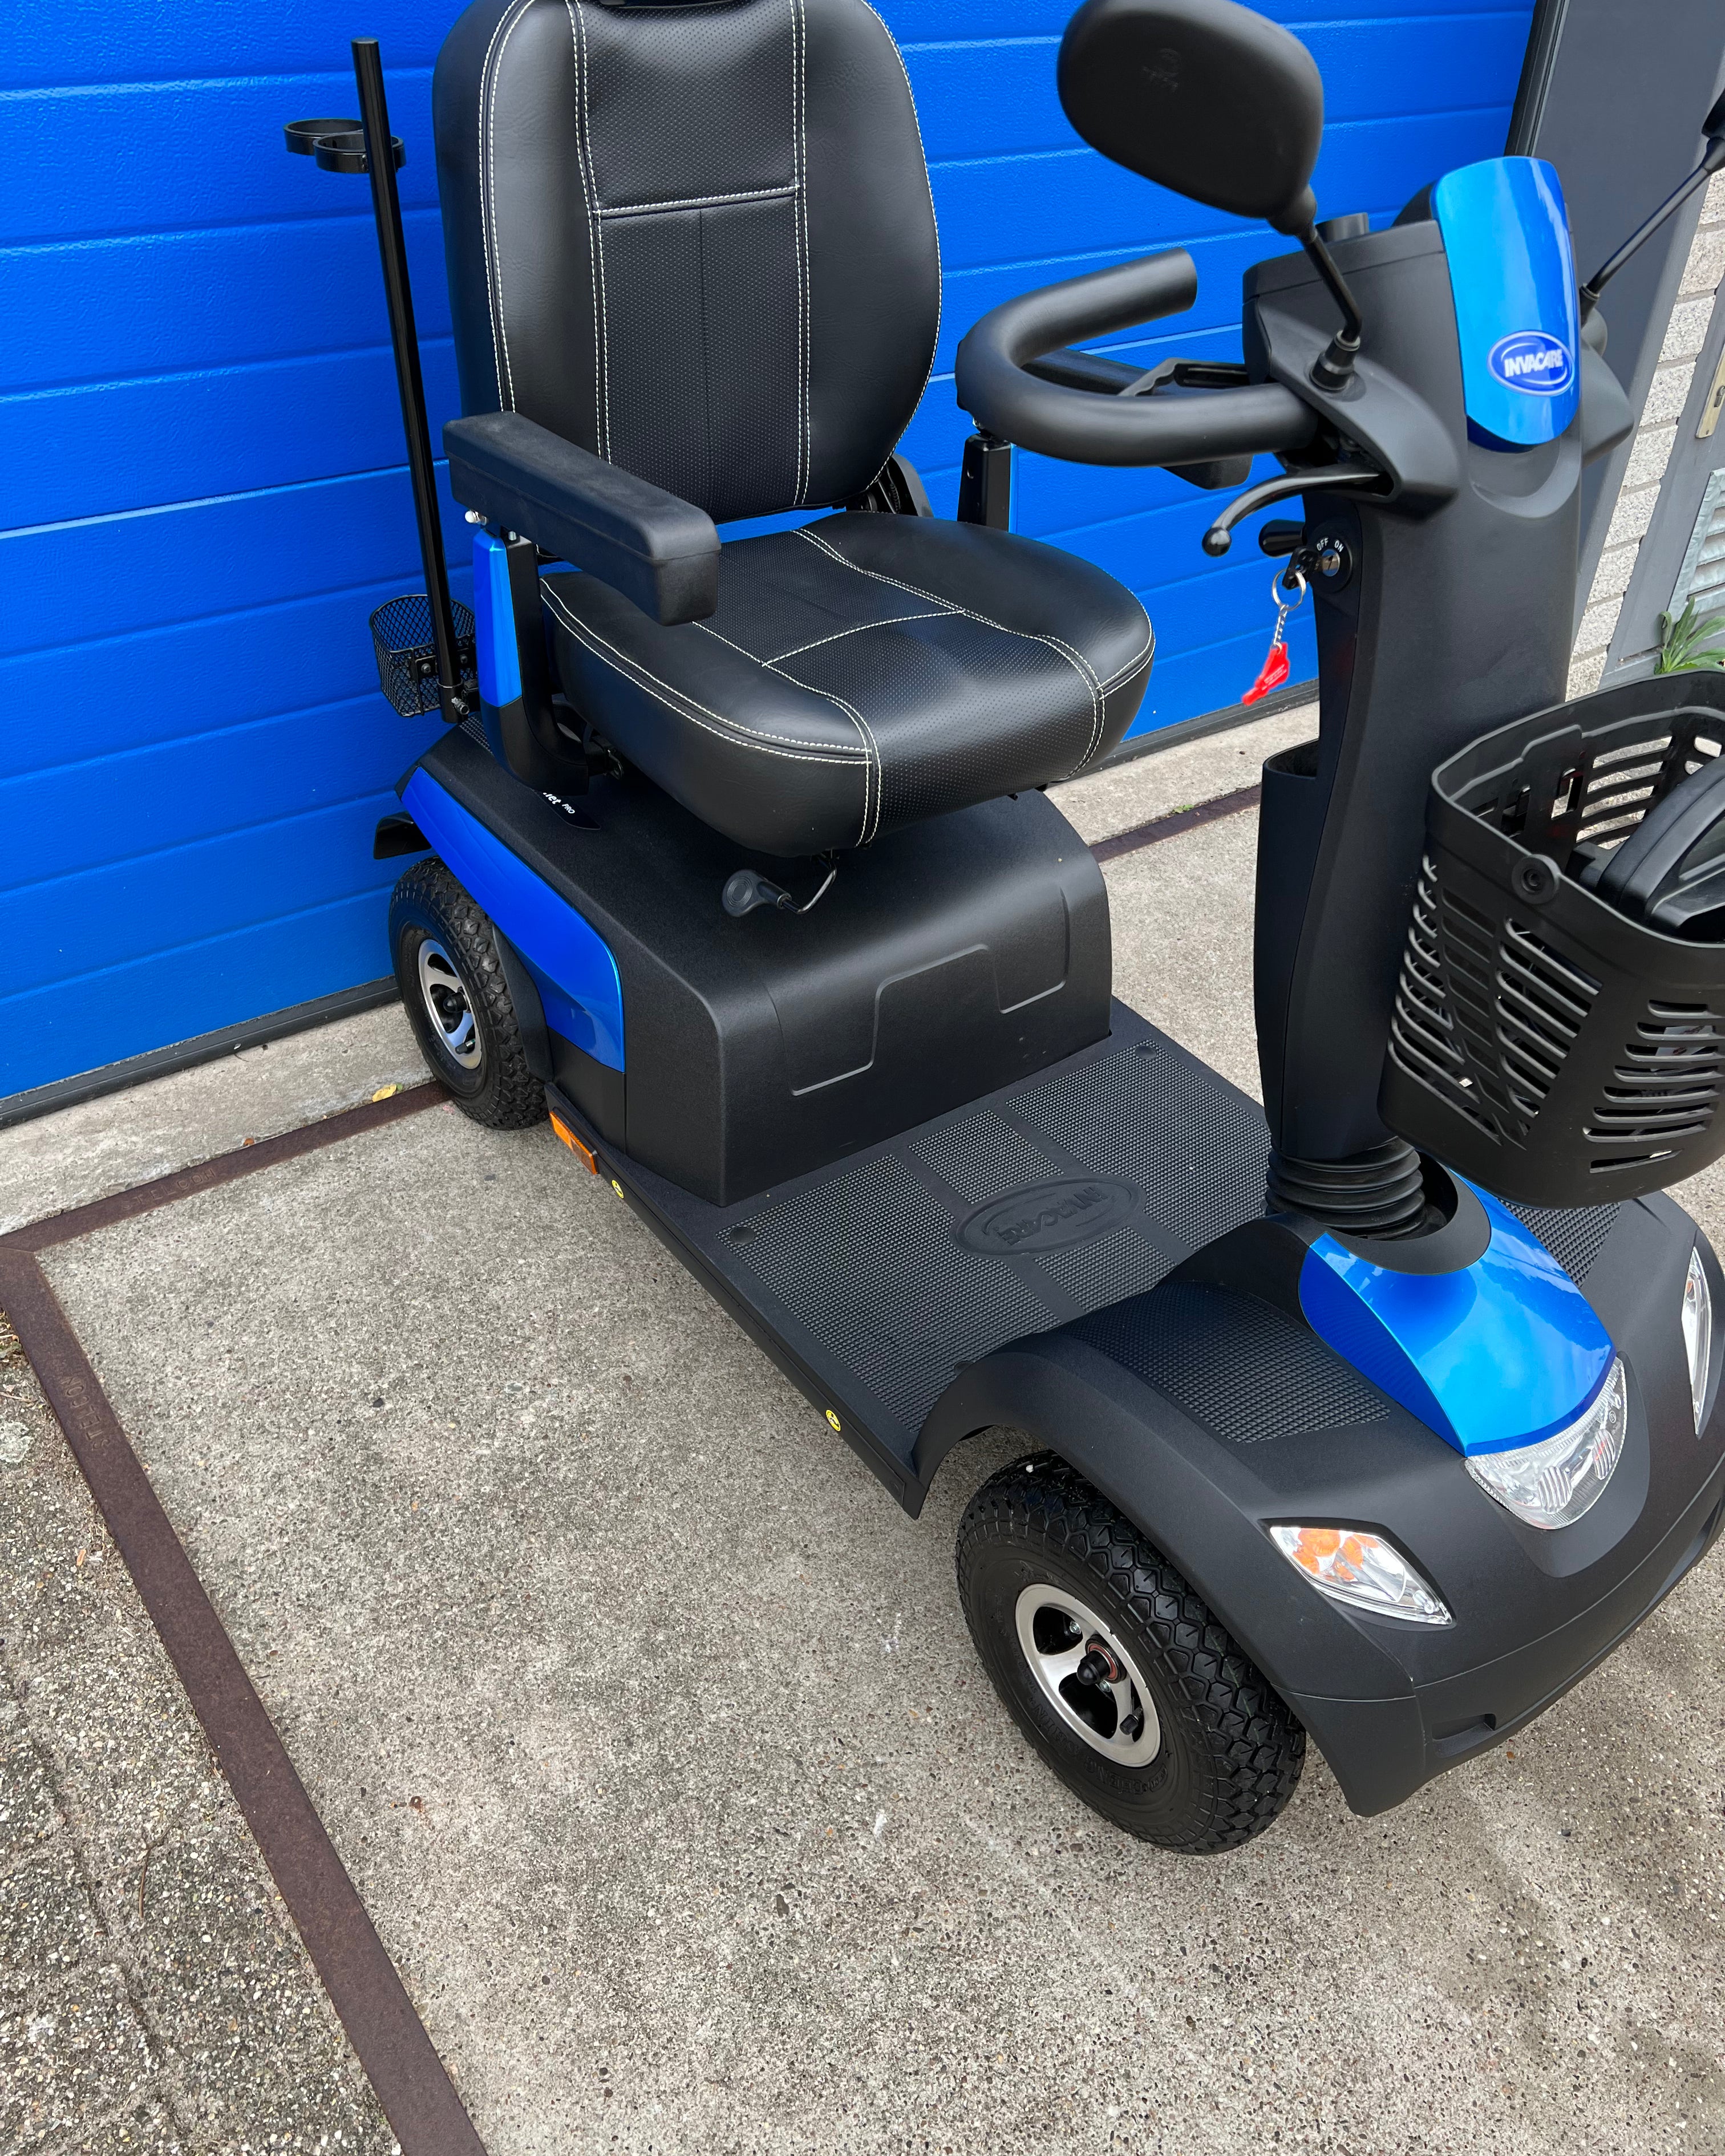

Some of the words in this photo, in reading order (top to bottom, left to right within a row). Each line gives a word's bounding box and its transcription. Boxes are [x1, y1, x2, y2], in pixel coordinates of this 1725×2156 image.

[1504, 348, 1563, 378] INVACARE
[1316, 537, 1329, 551] OFF
[1334, 539, 1345, 552] ON
[561, 803, 576, 814] PRO
[121, 1168, 216, 1211] STELCON
[60, 1376, 111, 1452] STELCON
[1033, 1703, 1080, 1758] SHIN
